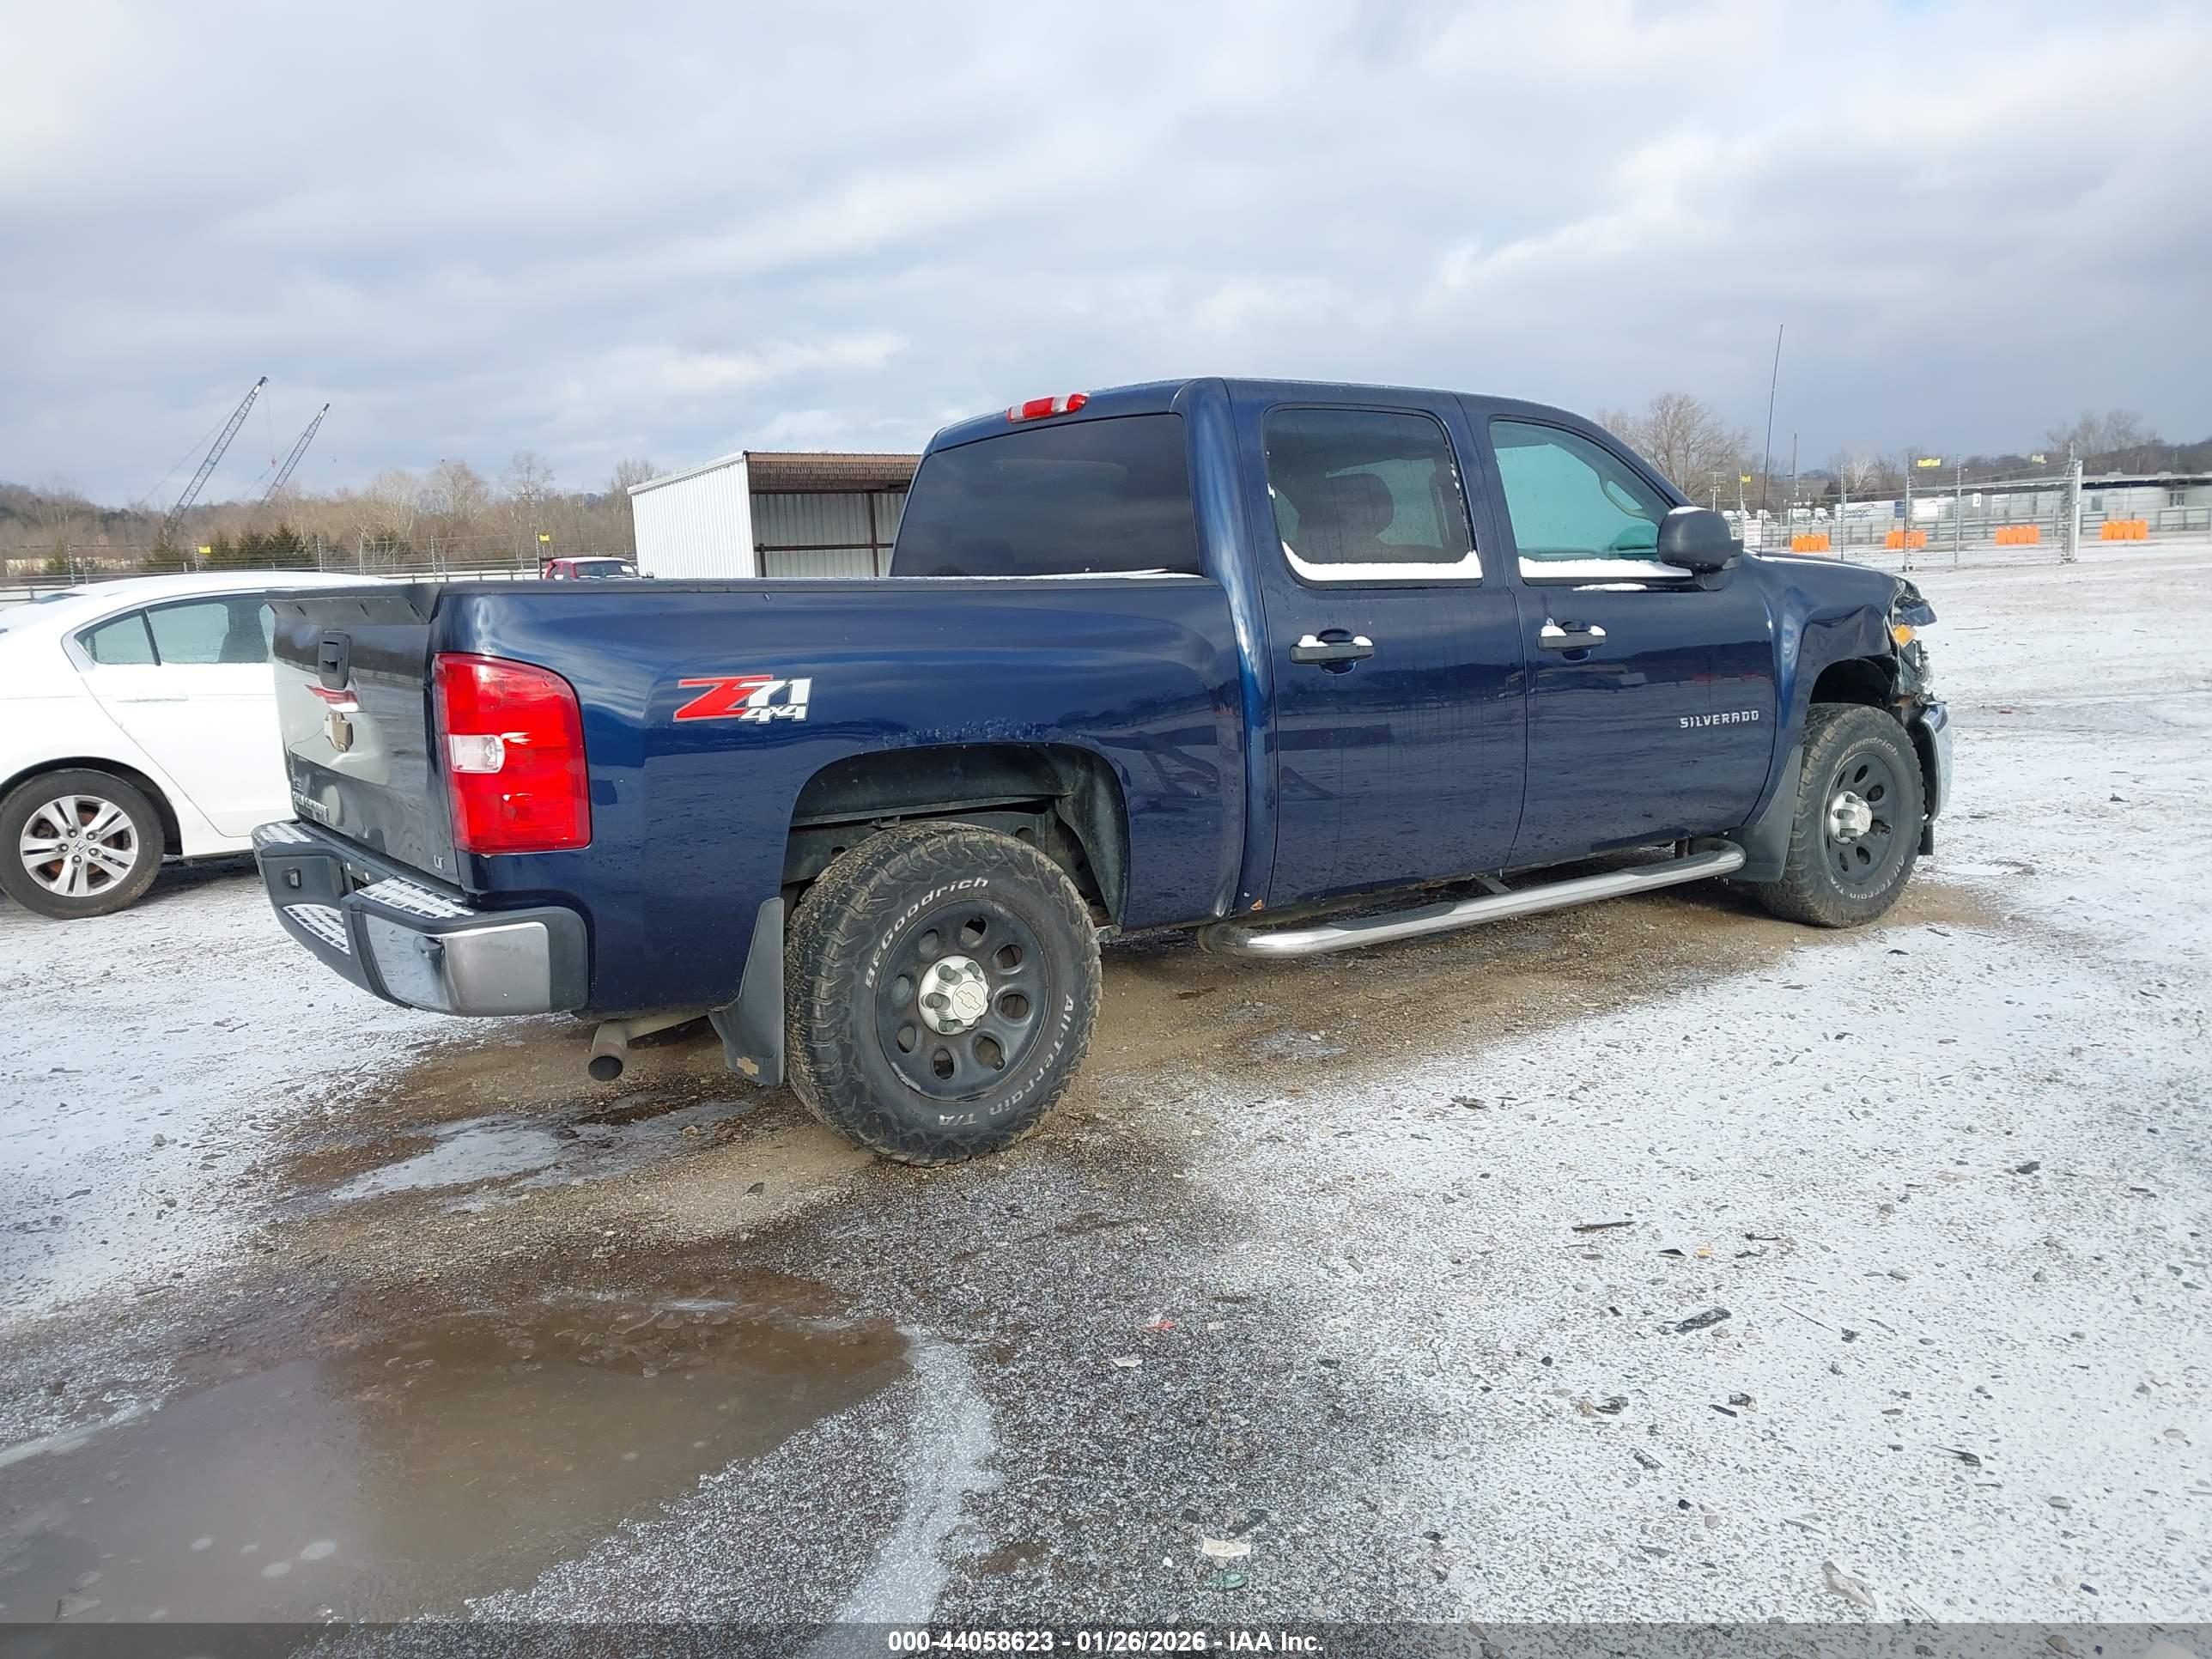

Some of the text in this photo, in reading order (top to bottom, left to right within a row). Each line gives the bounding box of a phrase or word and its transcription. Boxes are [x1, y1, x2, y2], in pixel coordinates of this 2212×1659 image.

[673, 674, 813, 723] Z71
[738, 705, 809, 725] 4x4
[1680, 710, 1759, 728] SILVERADO
[865, 877, 989, 988] BFGoodrich
[939, 994, 1074, 1127] All-Terrain T/A
